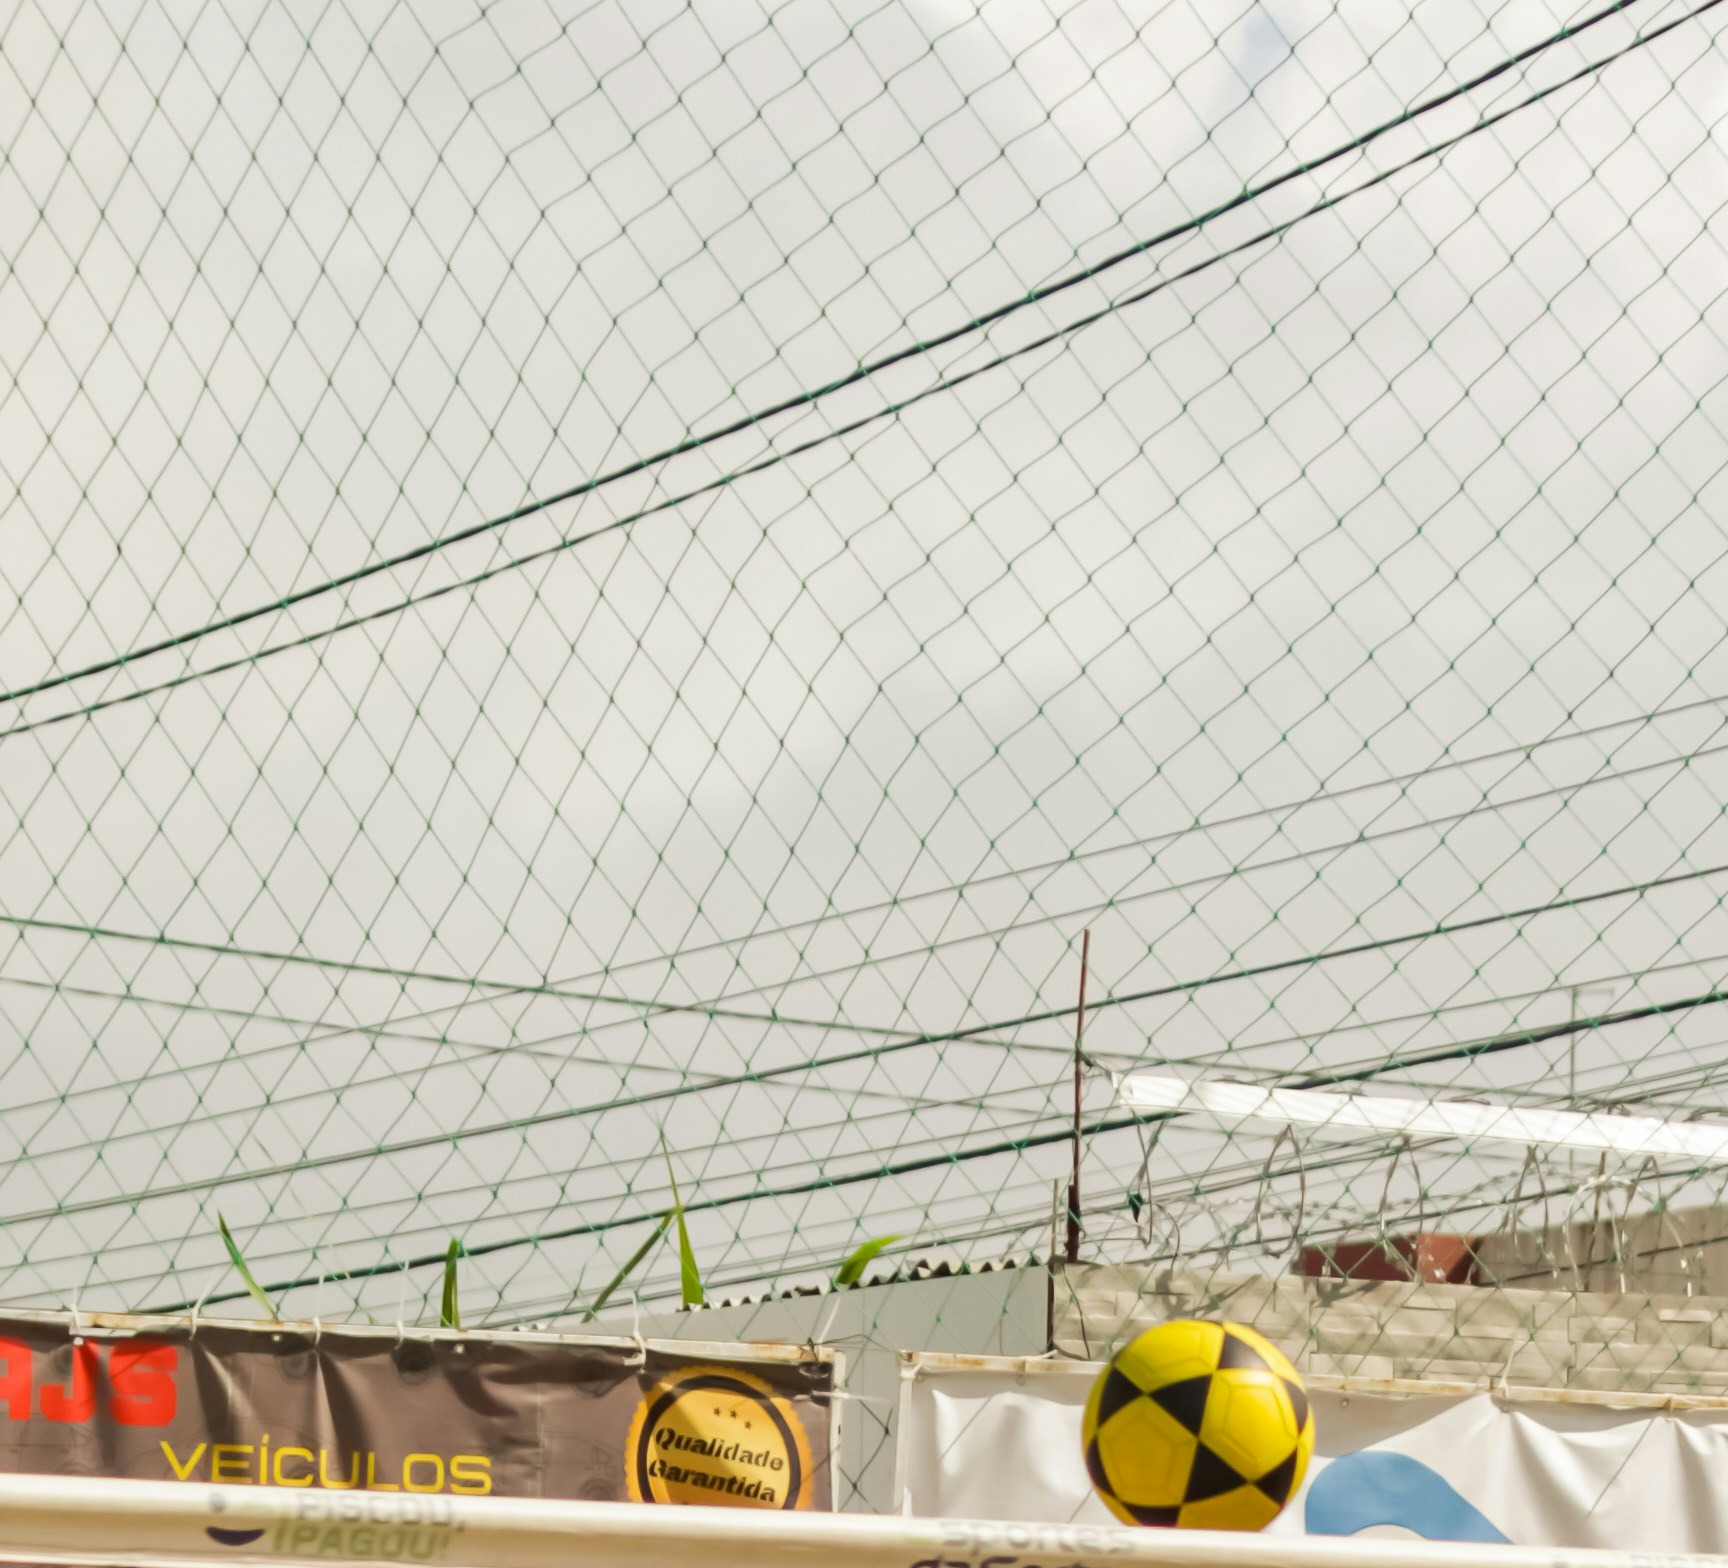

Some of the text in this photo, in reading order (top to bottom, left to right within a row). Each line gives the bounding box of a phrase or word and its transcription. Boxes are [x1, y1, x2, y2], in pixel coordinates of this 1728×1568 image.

[160, 1433, 493, 1496] VEÍCULOS
[655, 1427, 784, 1472] Qualidade
[649, 1458, 777, 1503] Garantida
